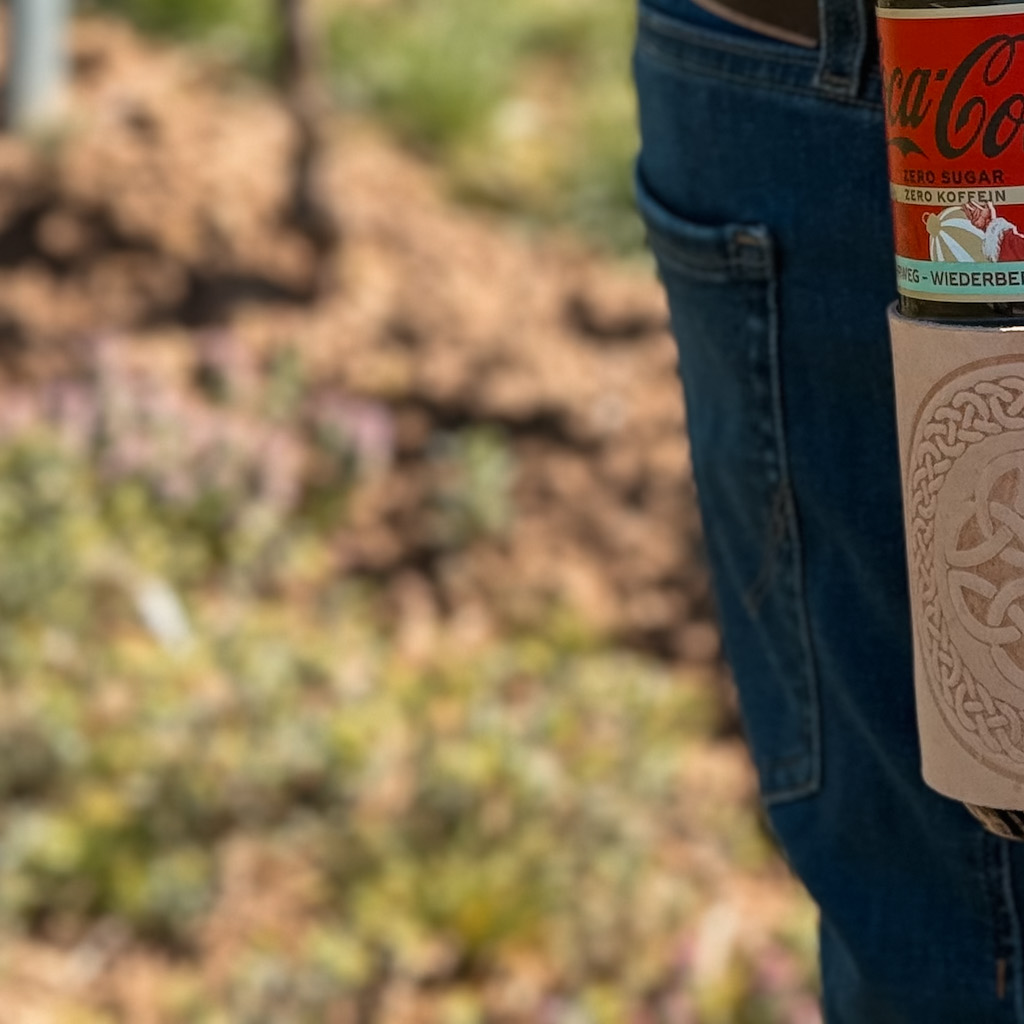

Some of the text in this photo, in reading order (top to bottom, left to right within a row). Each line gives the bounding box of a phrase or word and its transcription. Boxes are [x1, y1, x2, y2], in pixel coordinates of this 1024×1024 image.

[903, 169, 1005, 184] ZERO SUGAR
[904, 188, 1006, 204] ZERO KOFFEIN
